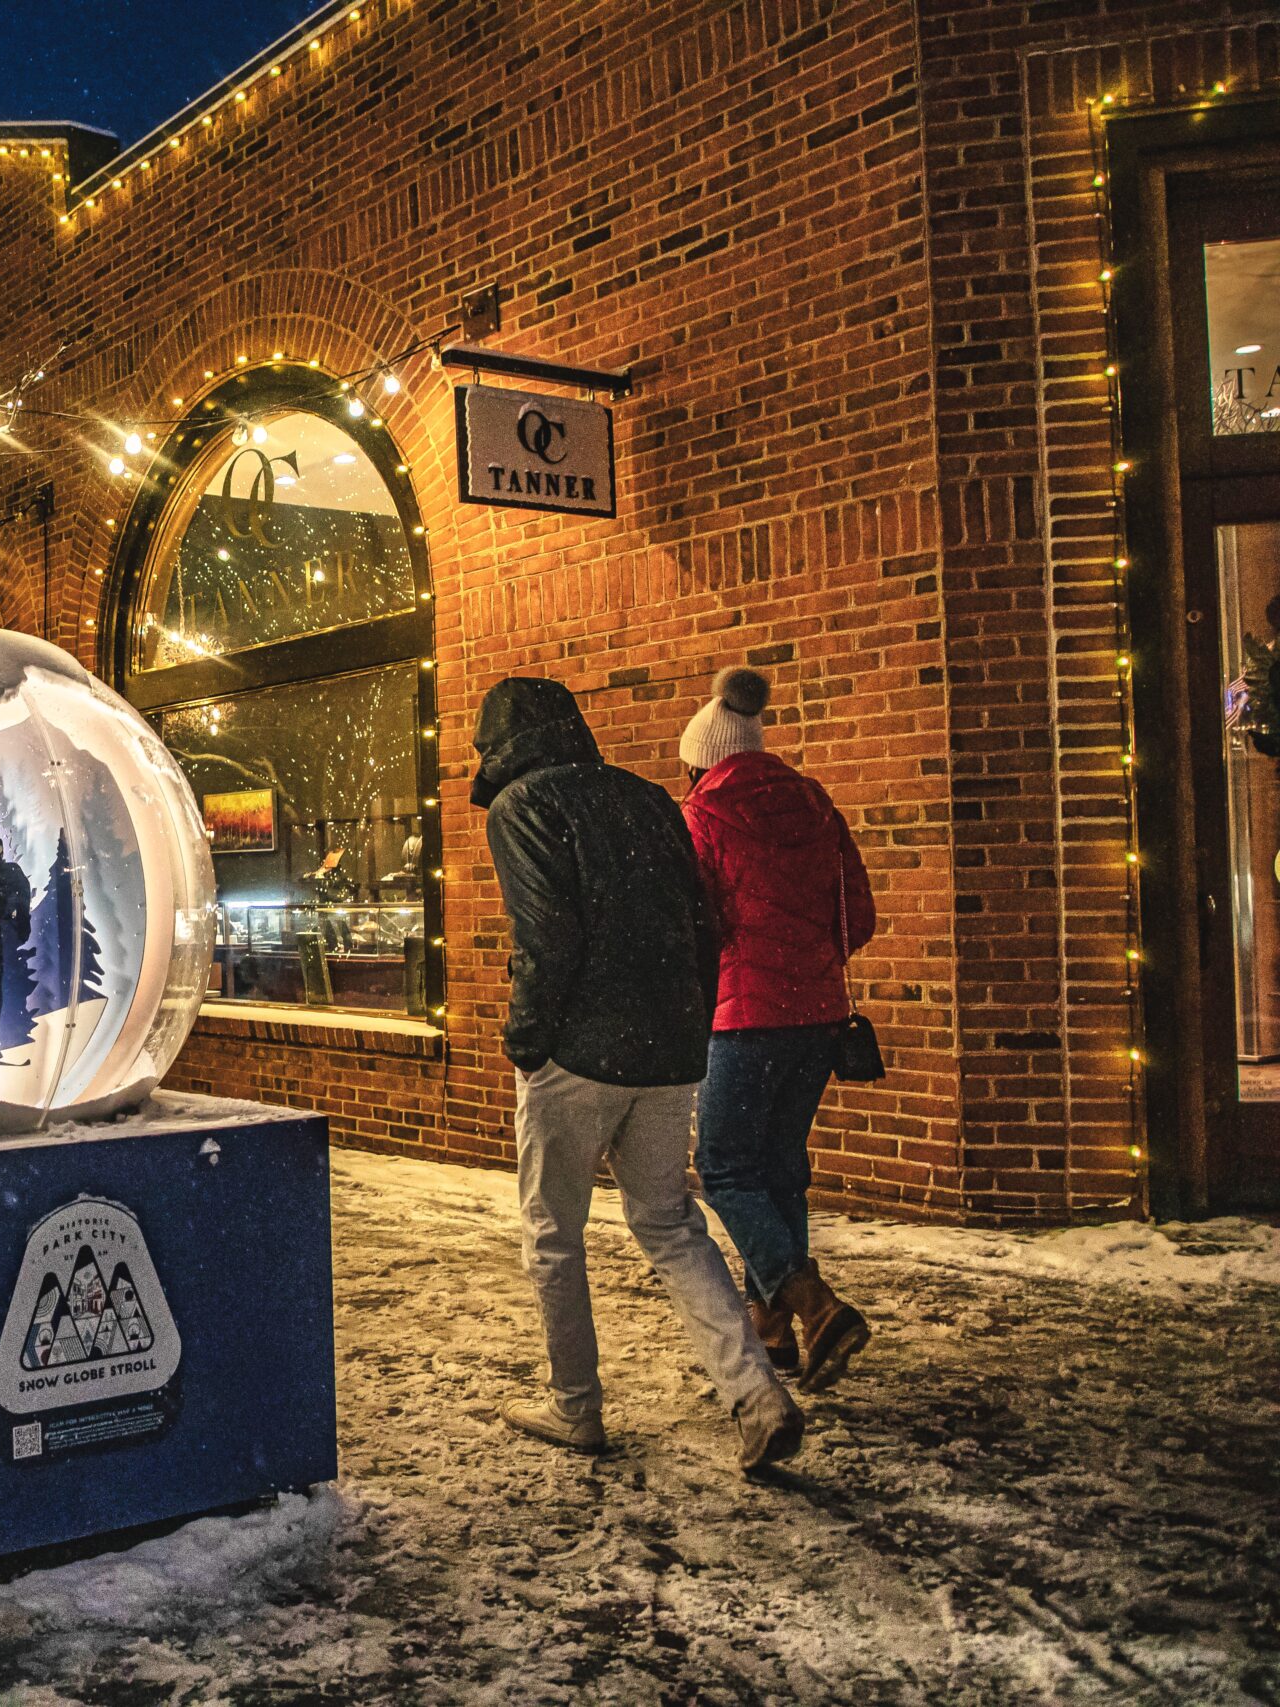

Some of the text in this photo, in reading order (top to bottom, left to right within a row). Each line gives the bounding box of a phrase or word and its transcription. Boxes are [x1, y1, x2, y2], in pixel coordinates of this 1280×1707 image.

[517, 410, 567, 464] OC
[488, 467, 596, 500] TANNER
[60, 1218, 109, 1231] HISTORIC
[43, 1229, 126, 1256] PARK CITY
[19, 1359, 157, 1392] SNOW GLOBE STROLL
